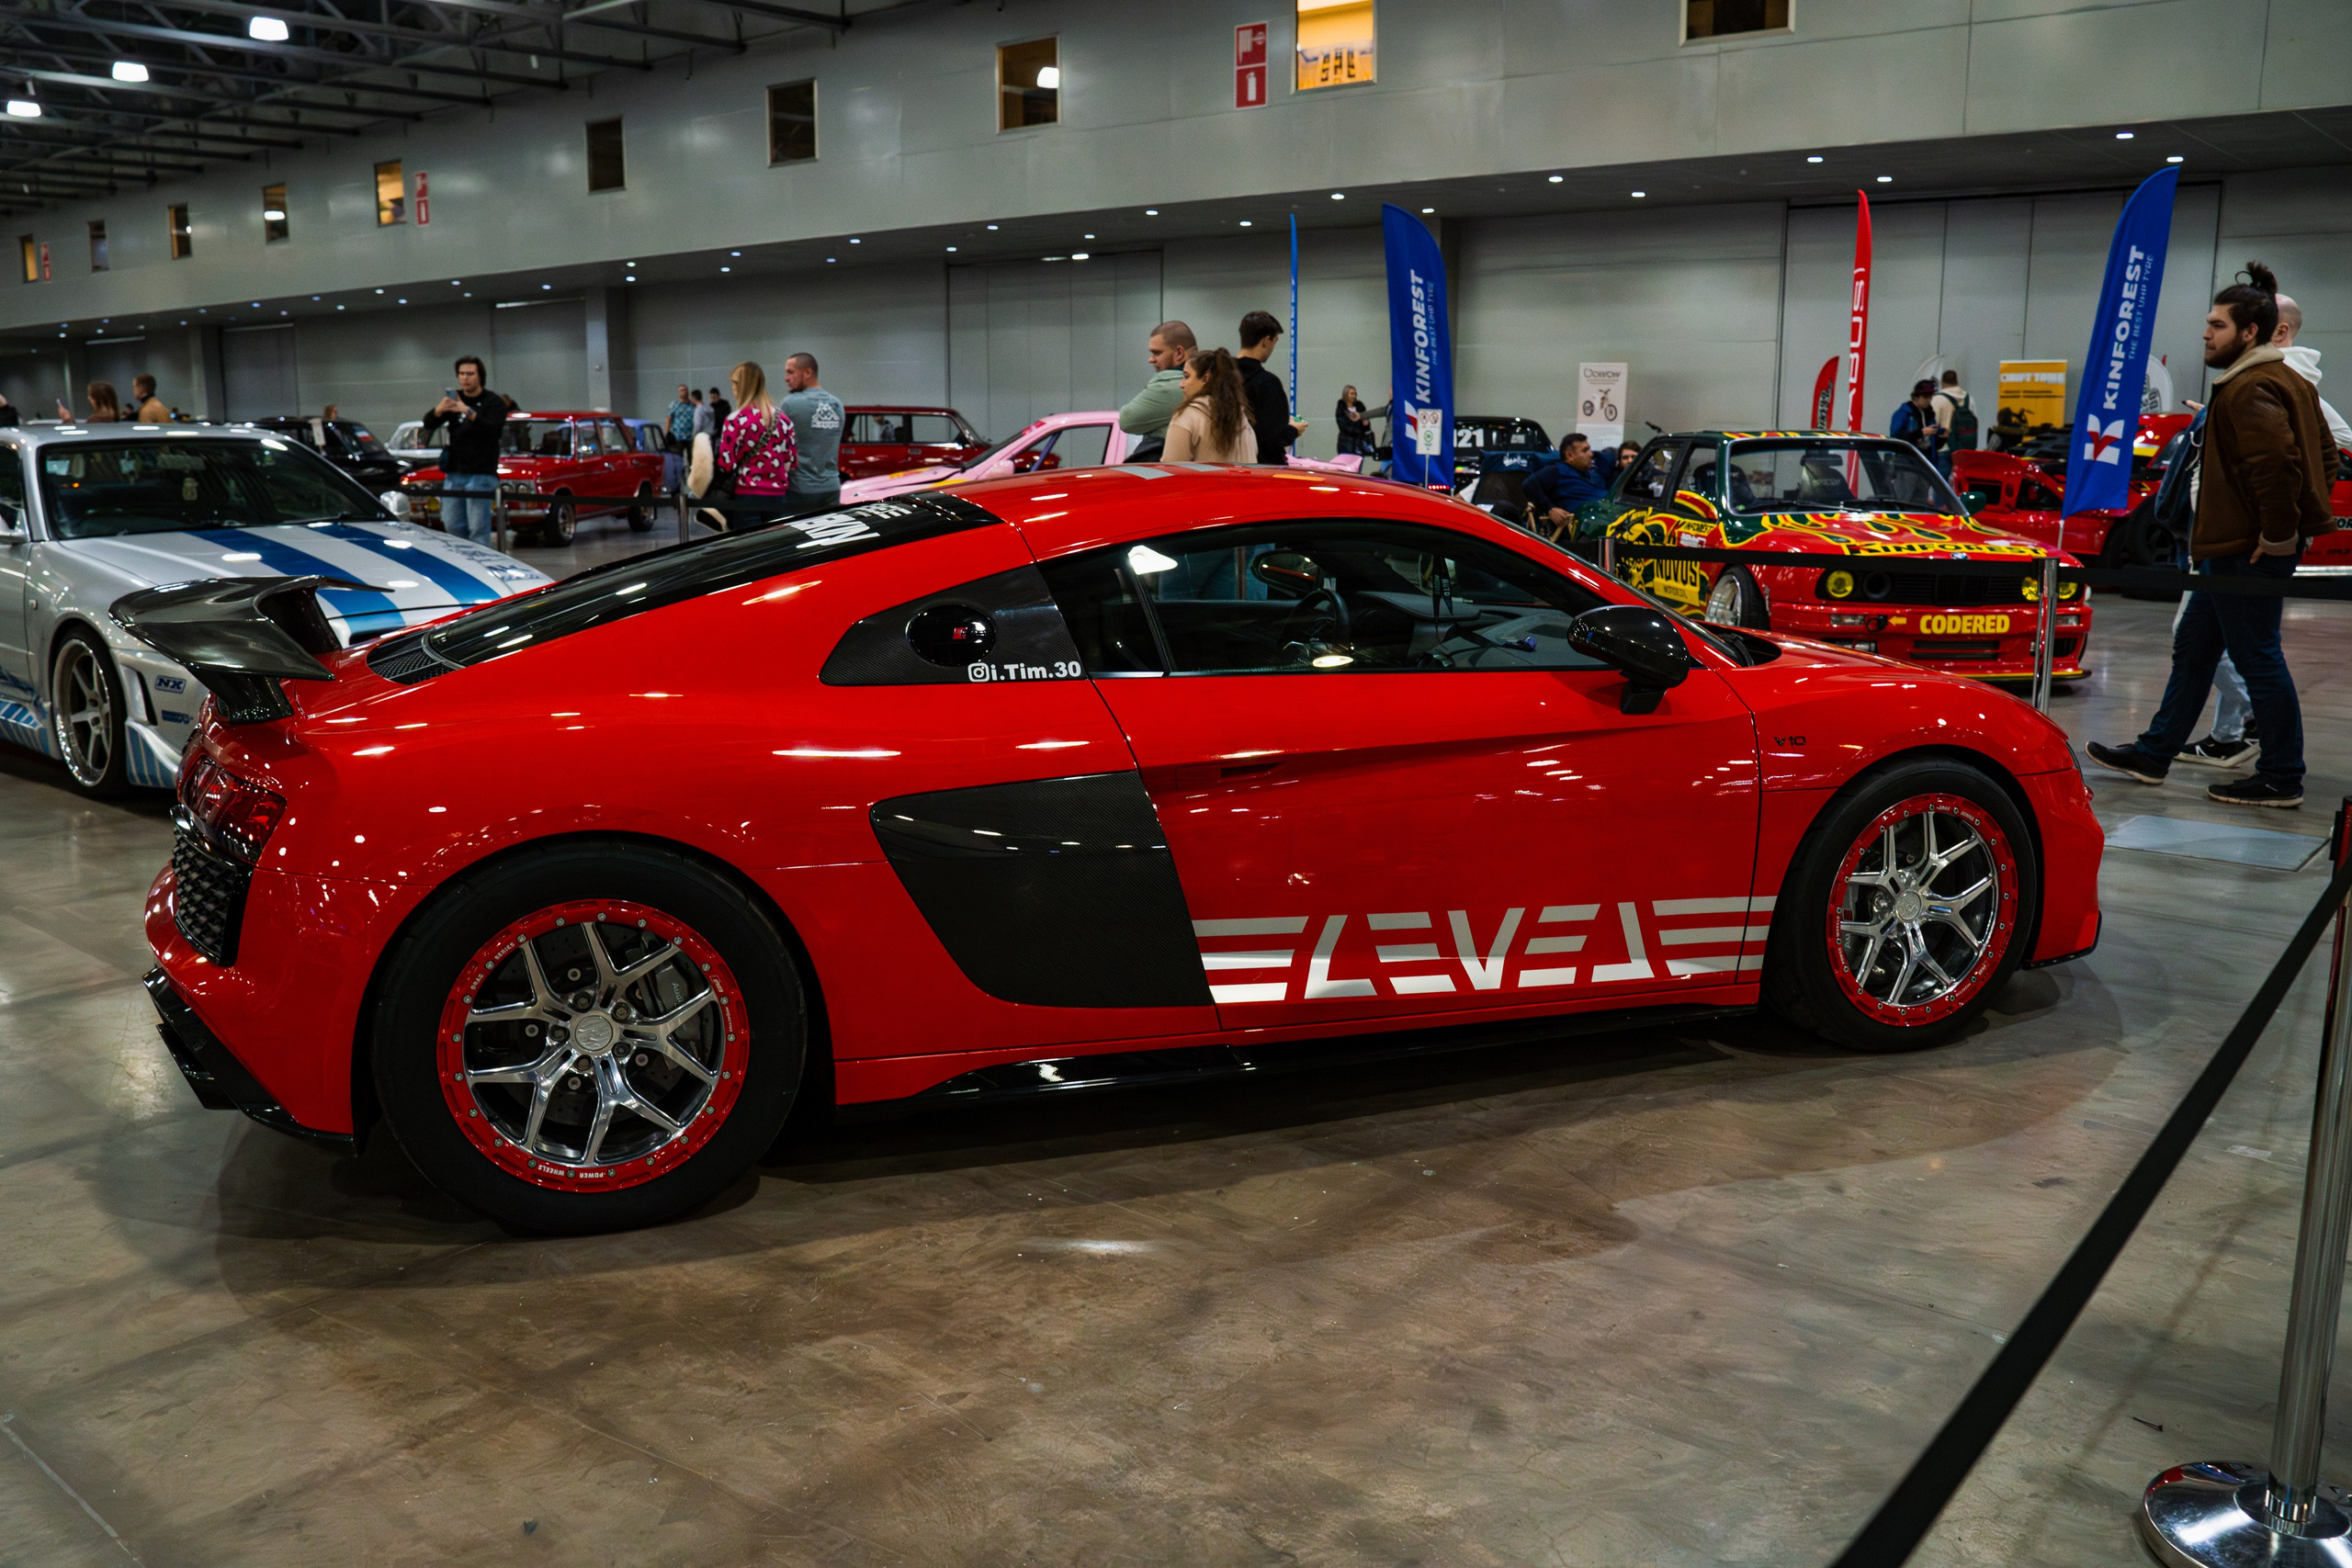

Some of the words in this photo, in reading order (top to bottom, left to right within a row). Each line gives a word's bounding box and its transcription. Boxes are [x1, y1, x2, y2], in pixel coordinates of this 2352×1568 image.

[1410, 268, 1430, 404] KINFOREST
[2103, 244, 2144, 411] KINFOREST
[1842, 541, 2047, 557] KINFOREST
[1655, 558, 1698, 587] NOVUS
[1919, 614, 2010, 635] CODERED
[157, 677, 184, 690] NX
[1774, 736, 1806, 746] V10
[672, 982, 684, 1003] Audi
[537, 1164, 565, 1177] WHEELS
